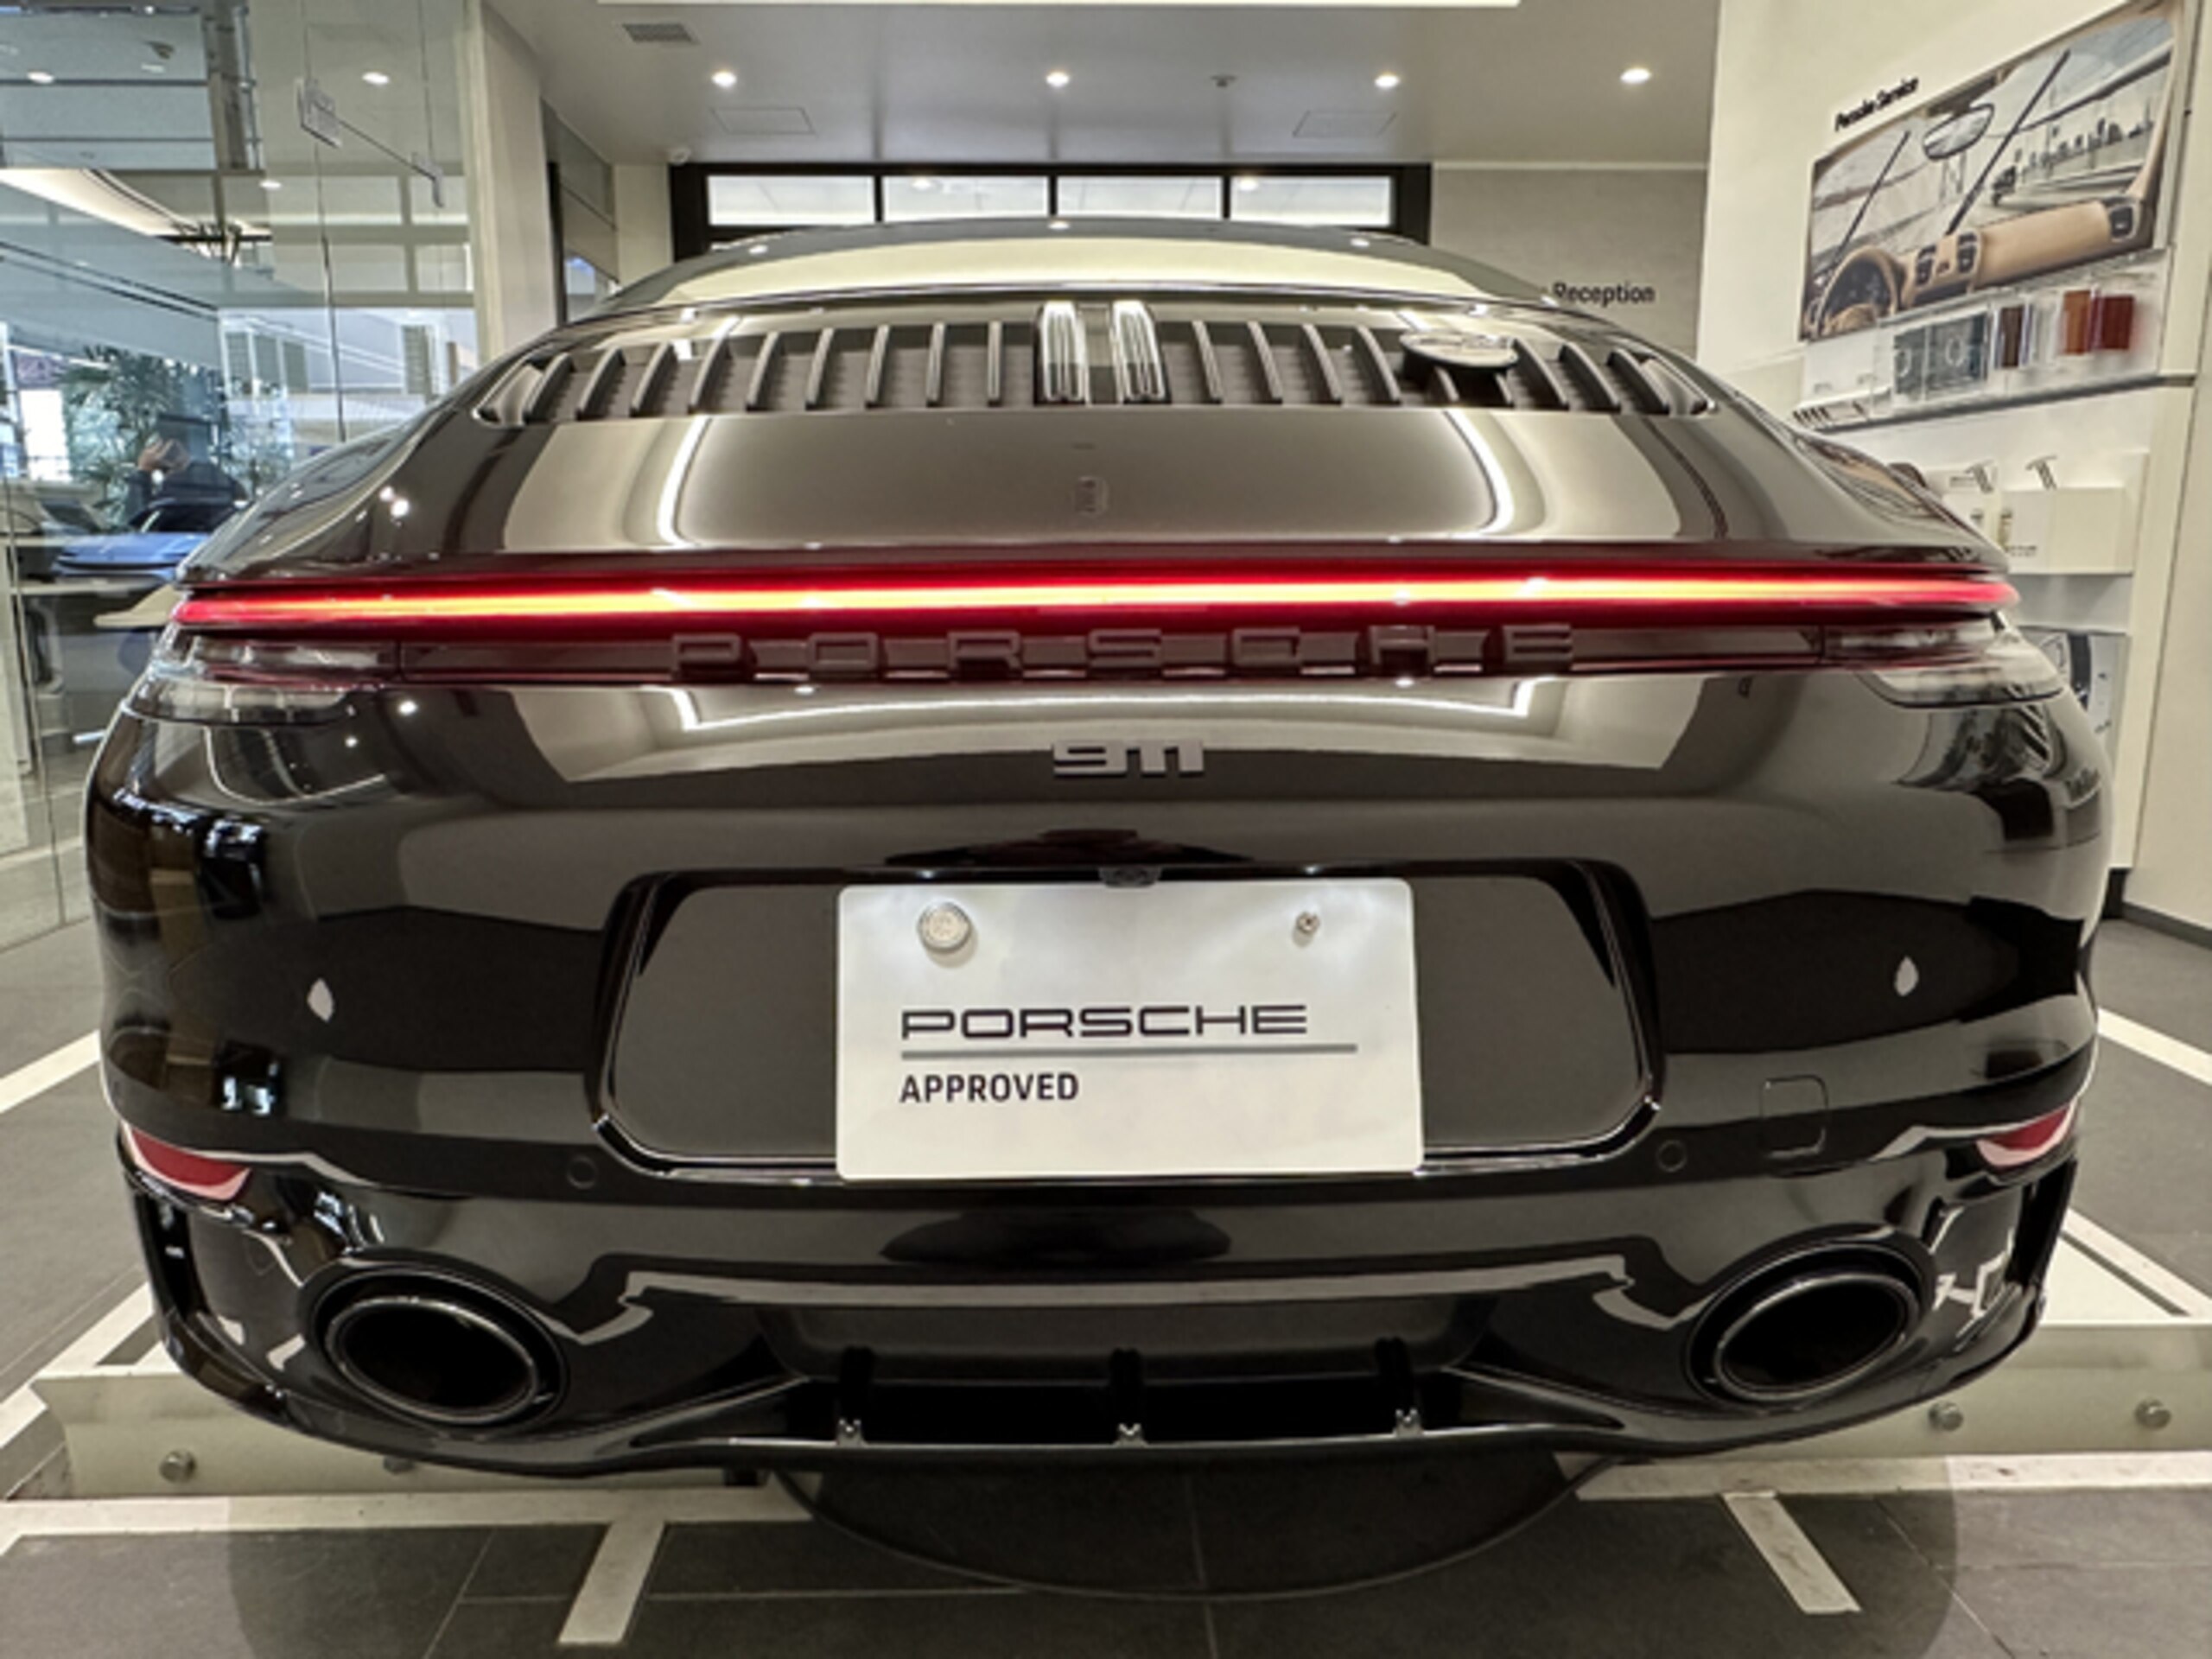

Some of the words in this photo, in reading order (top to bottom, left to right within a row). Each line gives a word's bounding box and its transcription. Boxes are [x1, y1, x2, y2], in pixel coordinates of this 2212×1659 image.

[1553, 281, 1656, 308] Reception
[671, 624, 1573, 680] PORSCHE
[1052, 739, 1205, 777] 911
[900, 1004, 1307, 1039] PORSCHE
[899, 1072, 1079, 1103] APPROVED
